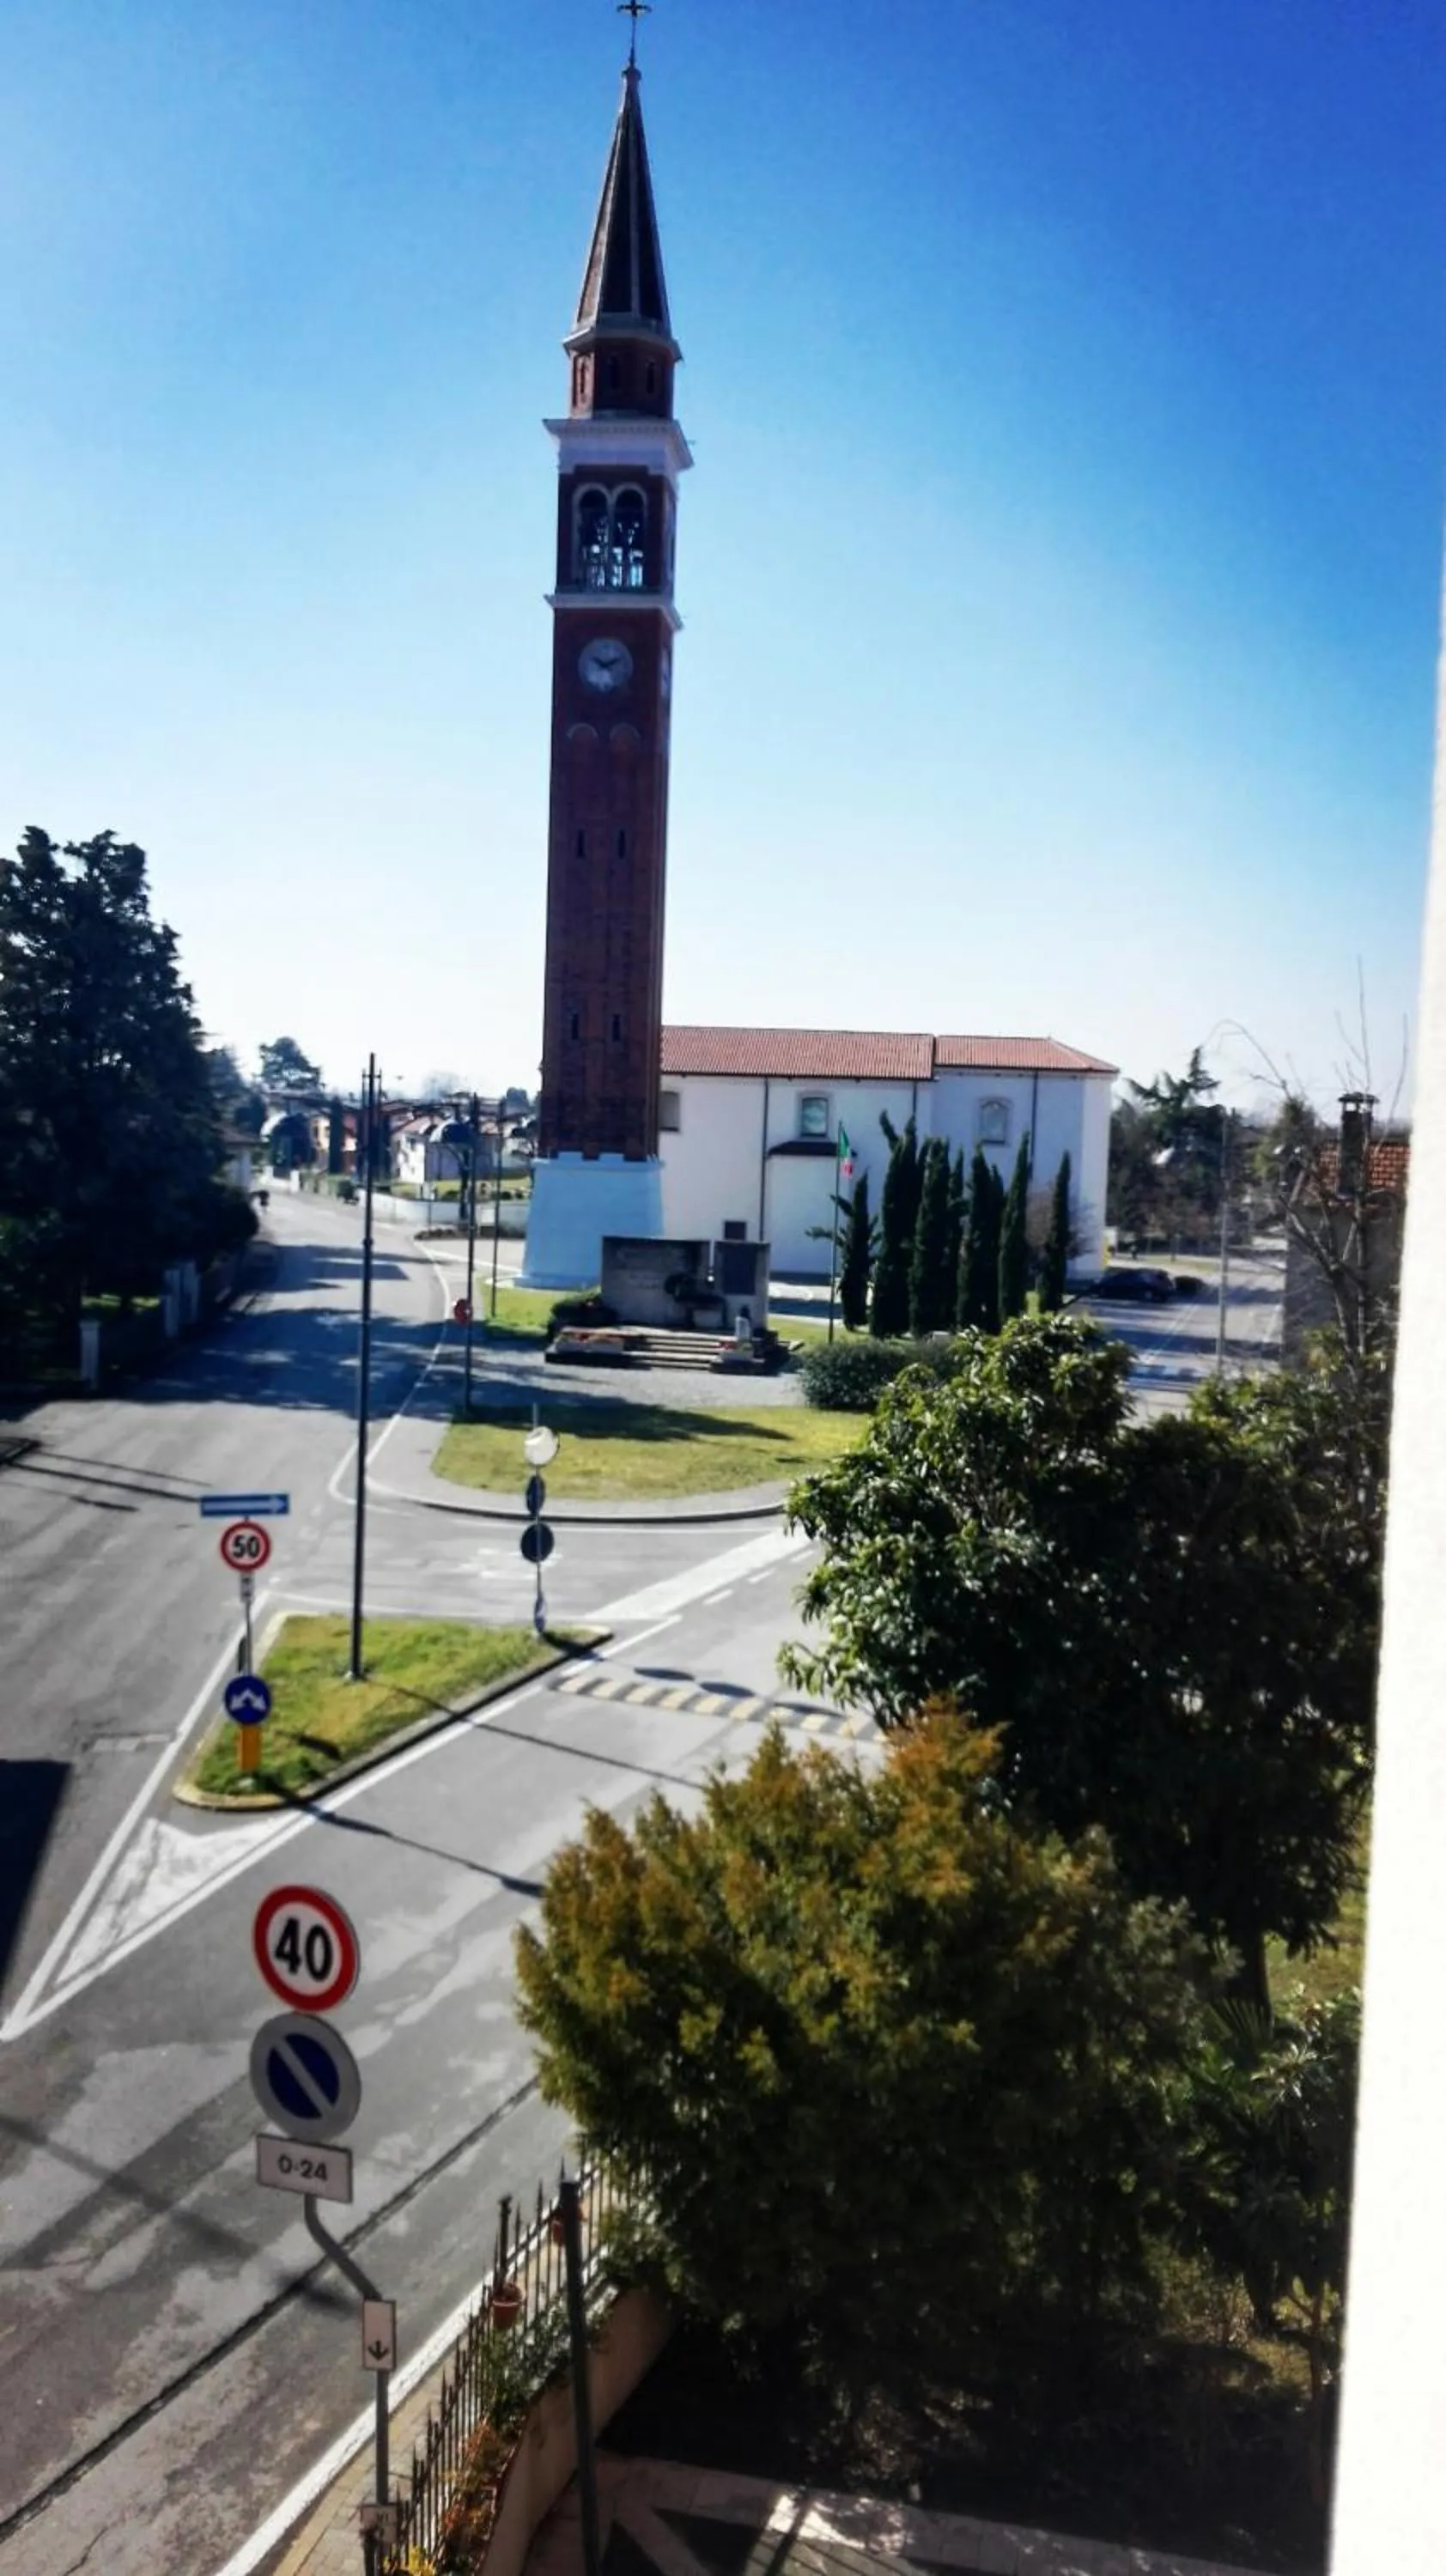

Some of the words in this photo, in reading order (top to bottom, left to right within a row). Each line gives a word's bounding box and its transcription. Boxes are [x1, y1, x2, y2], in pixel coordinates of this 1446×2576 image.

[233, 1534, 260, 1558] 50
[276, 1917, 333, 1983] 40
[277, 2154, 328, 2182] 0-24
